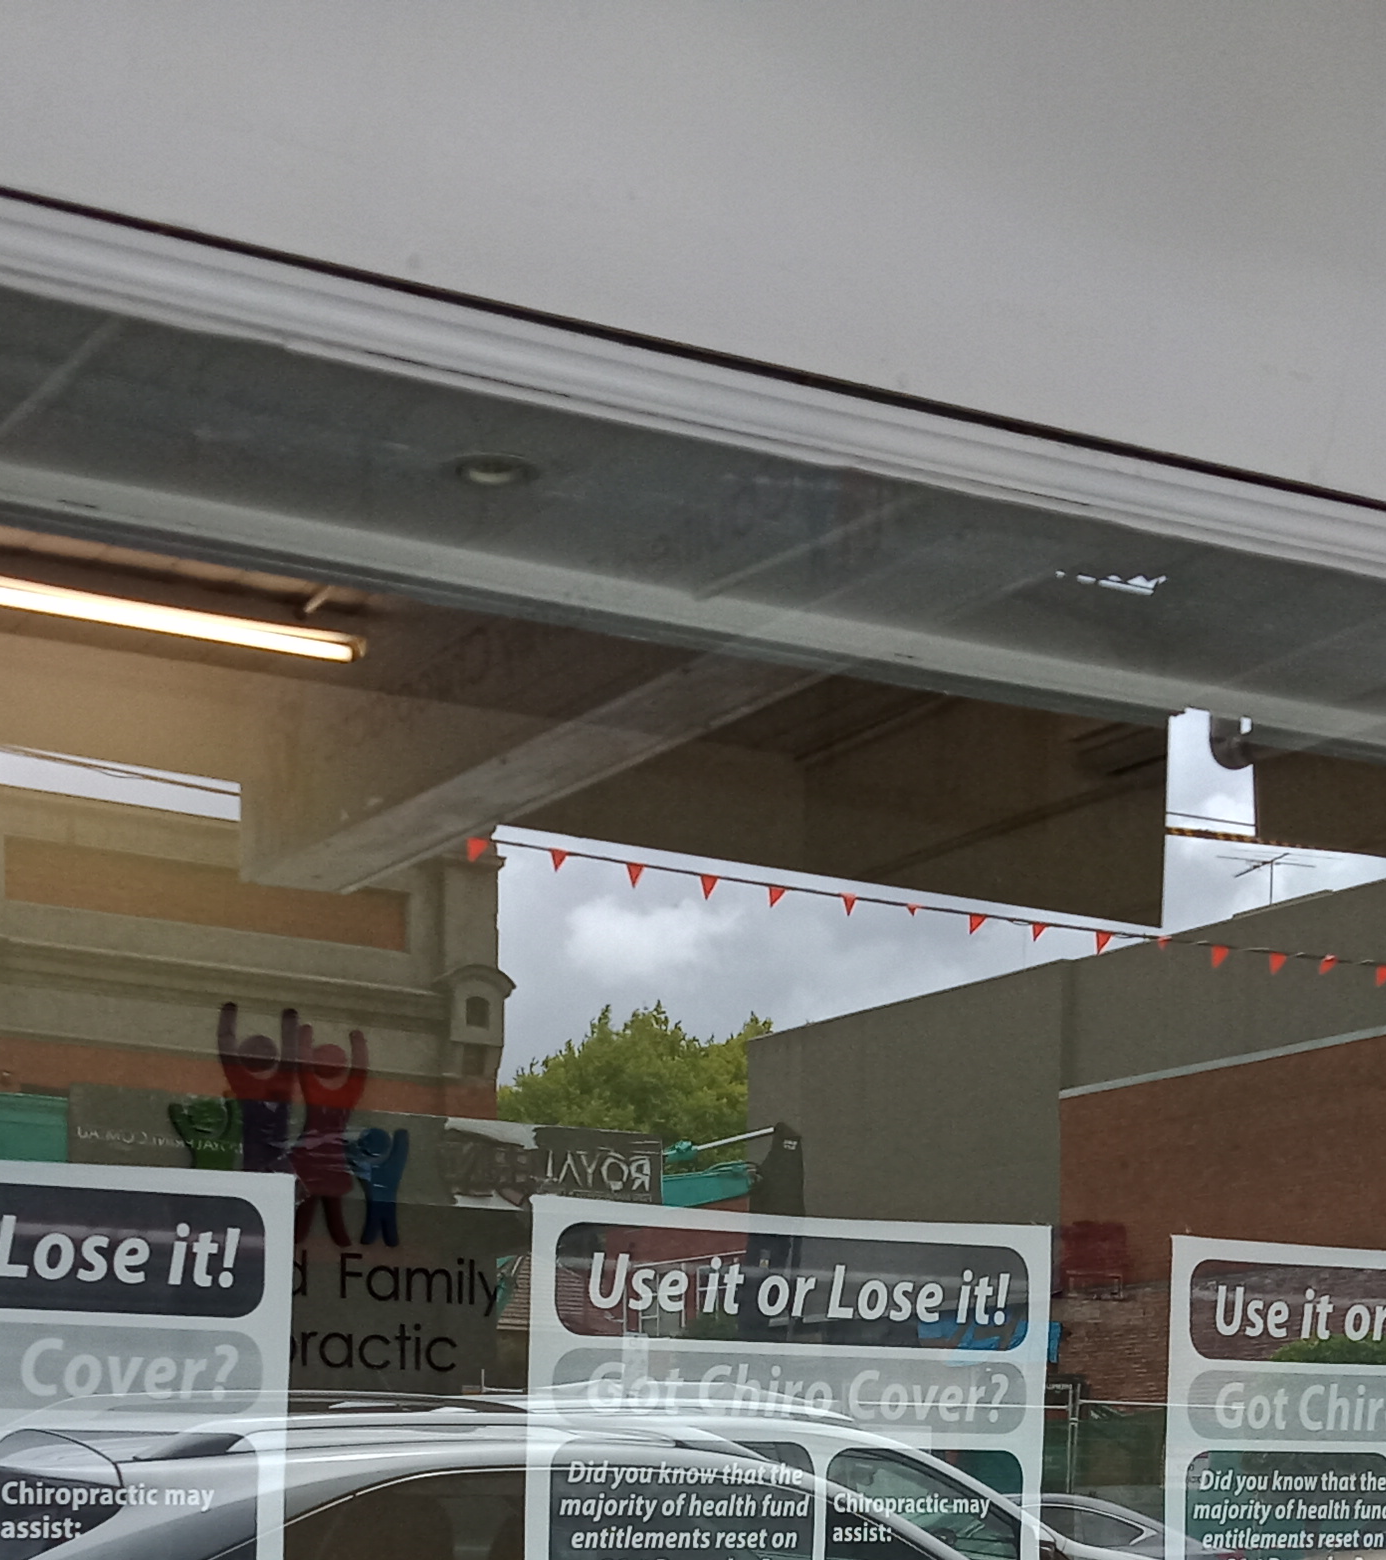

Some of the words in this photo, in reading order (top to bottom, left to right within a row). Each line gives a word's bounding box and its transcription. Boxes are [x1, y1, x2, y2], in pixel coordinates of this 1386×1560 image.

[165, 1222, 242, 1289] it!
[339, 1252, 501, 1318] Family
[588, 1252, 688, 1310] Use
[702, 1257, 744, 1315] it
[757, 1276, 815, 1318] or
[827, 1264, 944, 1322] Lose
[956, 1269, 1011, 1326] it!
[1214, 1284, 1289, 1339] Use
[1302, 1288, 1334, 1340] it
[21, 1338, 239, 1400] Cover?
[1, 1481, 158, 1509] Chiropractic
[163, 1486, 214, 1512] may
[833, 1492, 948, 1517] Chiropractic
[953, 1497, 990, 1519] may
[0, 1516, 82, 1541] assist:
[832, 1523, 892, 1543] assist:
